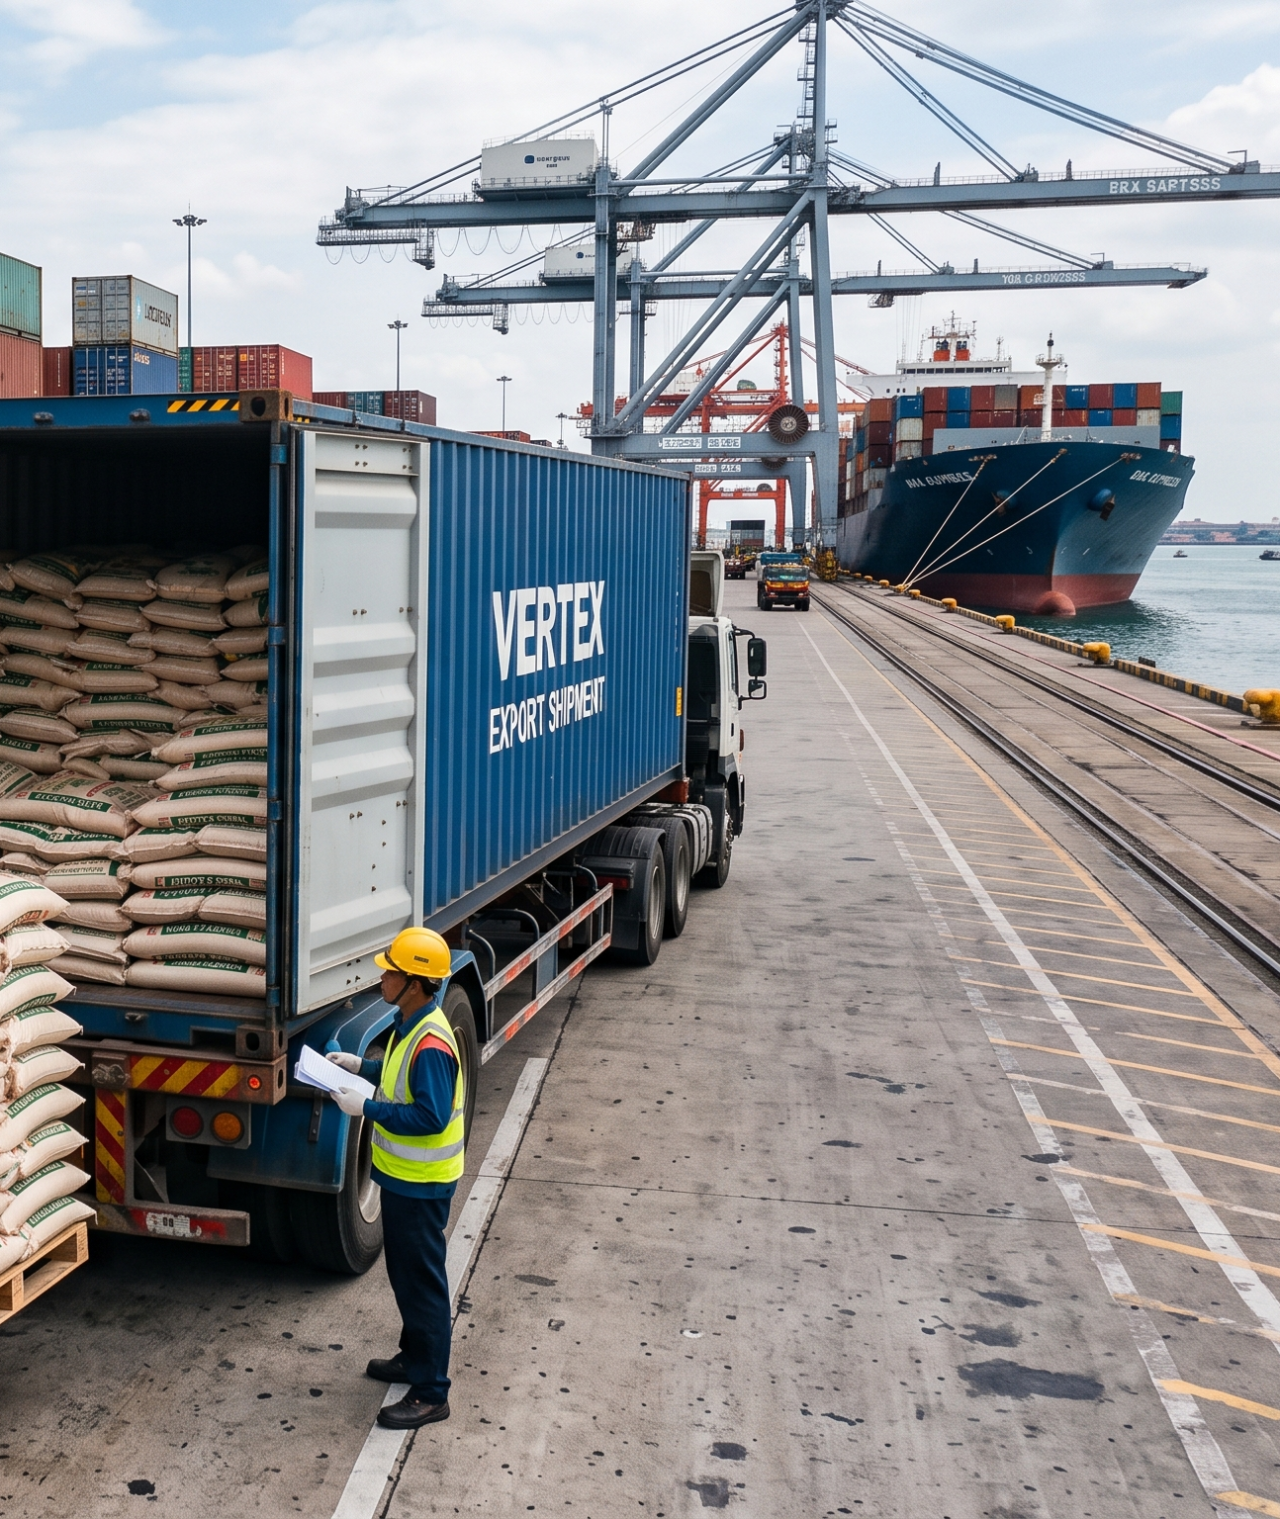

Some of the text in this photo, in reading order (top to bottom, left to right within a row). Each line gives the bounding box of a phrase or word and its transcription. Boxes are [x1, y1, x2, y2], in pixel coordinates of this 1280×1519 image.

[492, 580, 605, 681] VERTEX
[489, 675, 606, 755] EXPORT SHIPMENT
